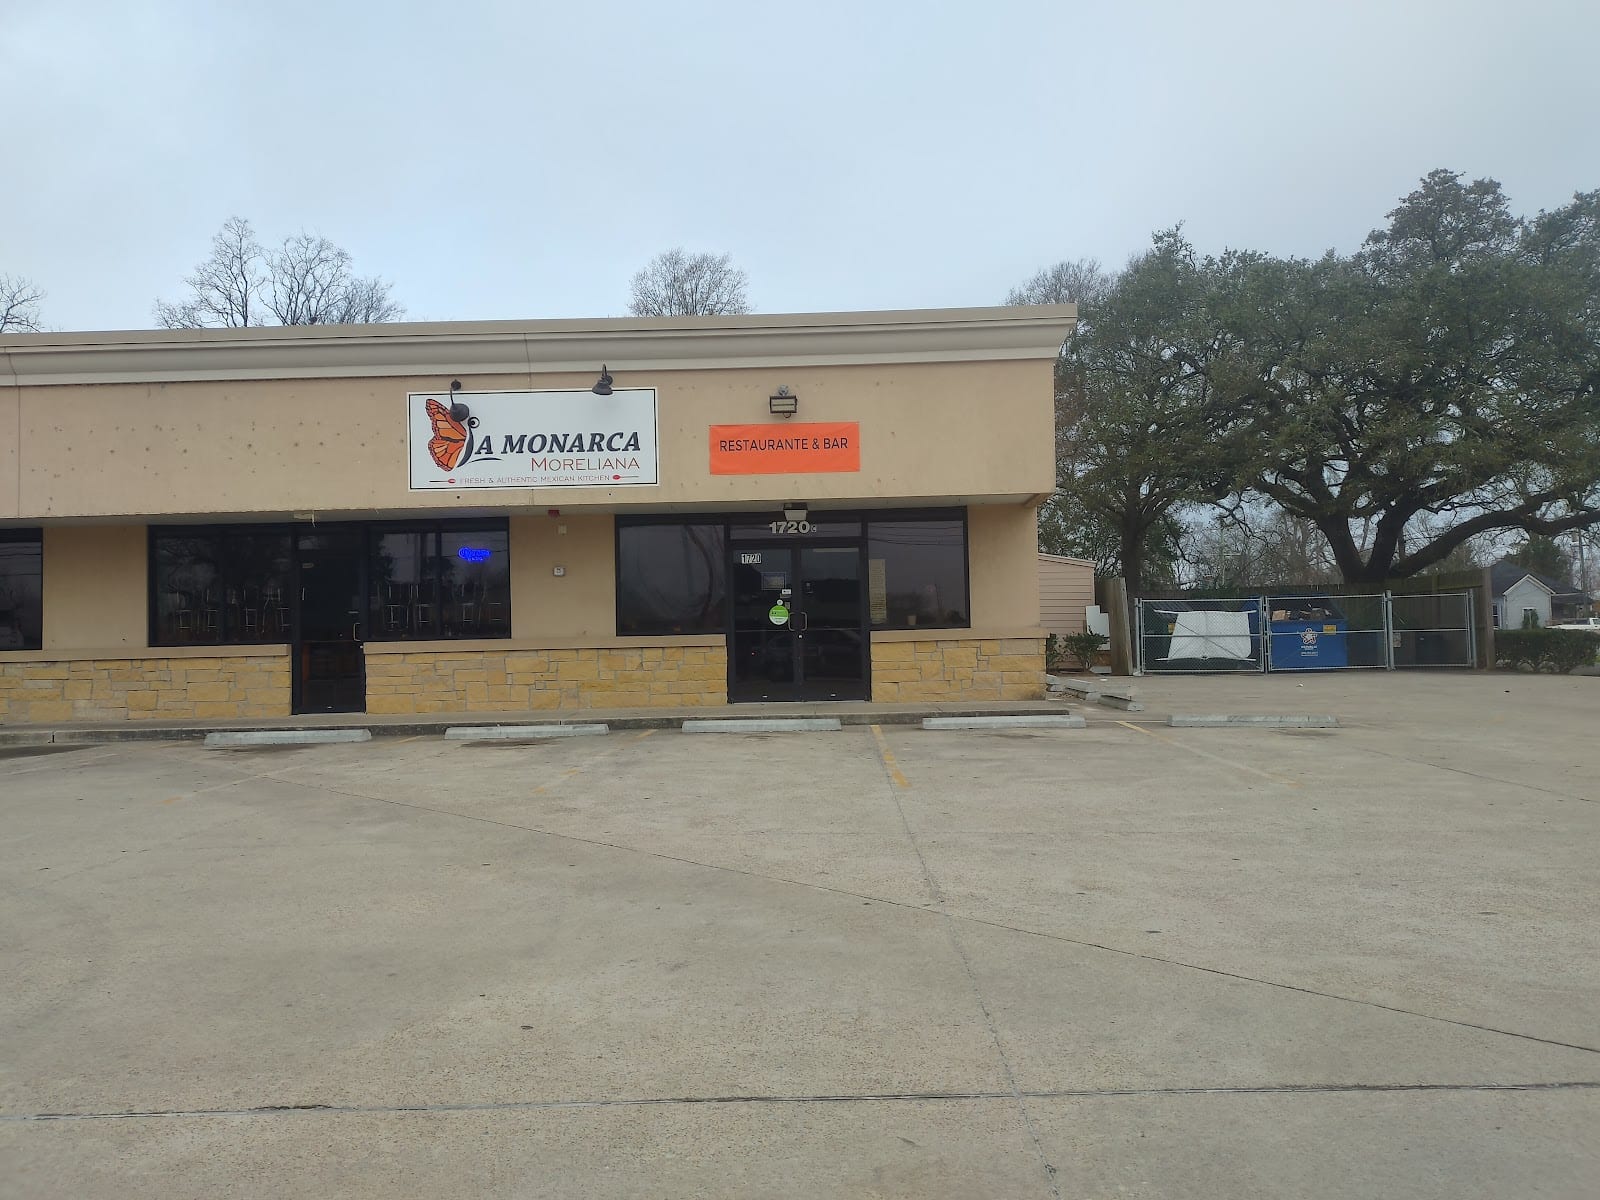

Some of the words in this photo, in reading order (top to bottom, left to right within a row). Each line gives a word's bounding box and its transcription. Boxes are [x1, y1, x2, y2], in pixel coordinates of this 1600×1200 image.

[501, 431, 640, 455] MONARCA
[719, 438, 809, 452] RESTAURANTE
[812, 438, 820, 450] &
[823, 437, 849, 450] BAR
[531, 456, 640, 472] MORELIANA
[496, 476, 538, 485] AUTHENTIC
[540, 475, 575, 483] MEXICAN
[577, 474, 610, 482] KITCHEN
[741, 553, 762, 564] 1720
